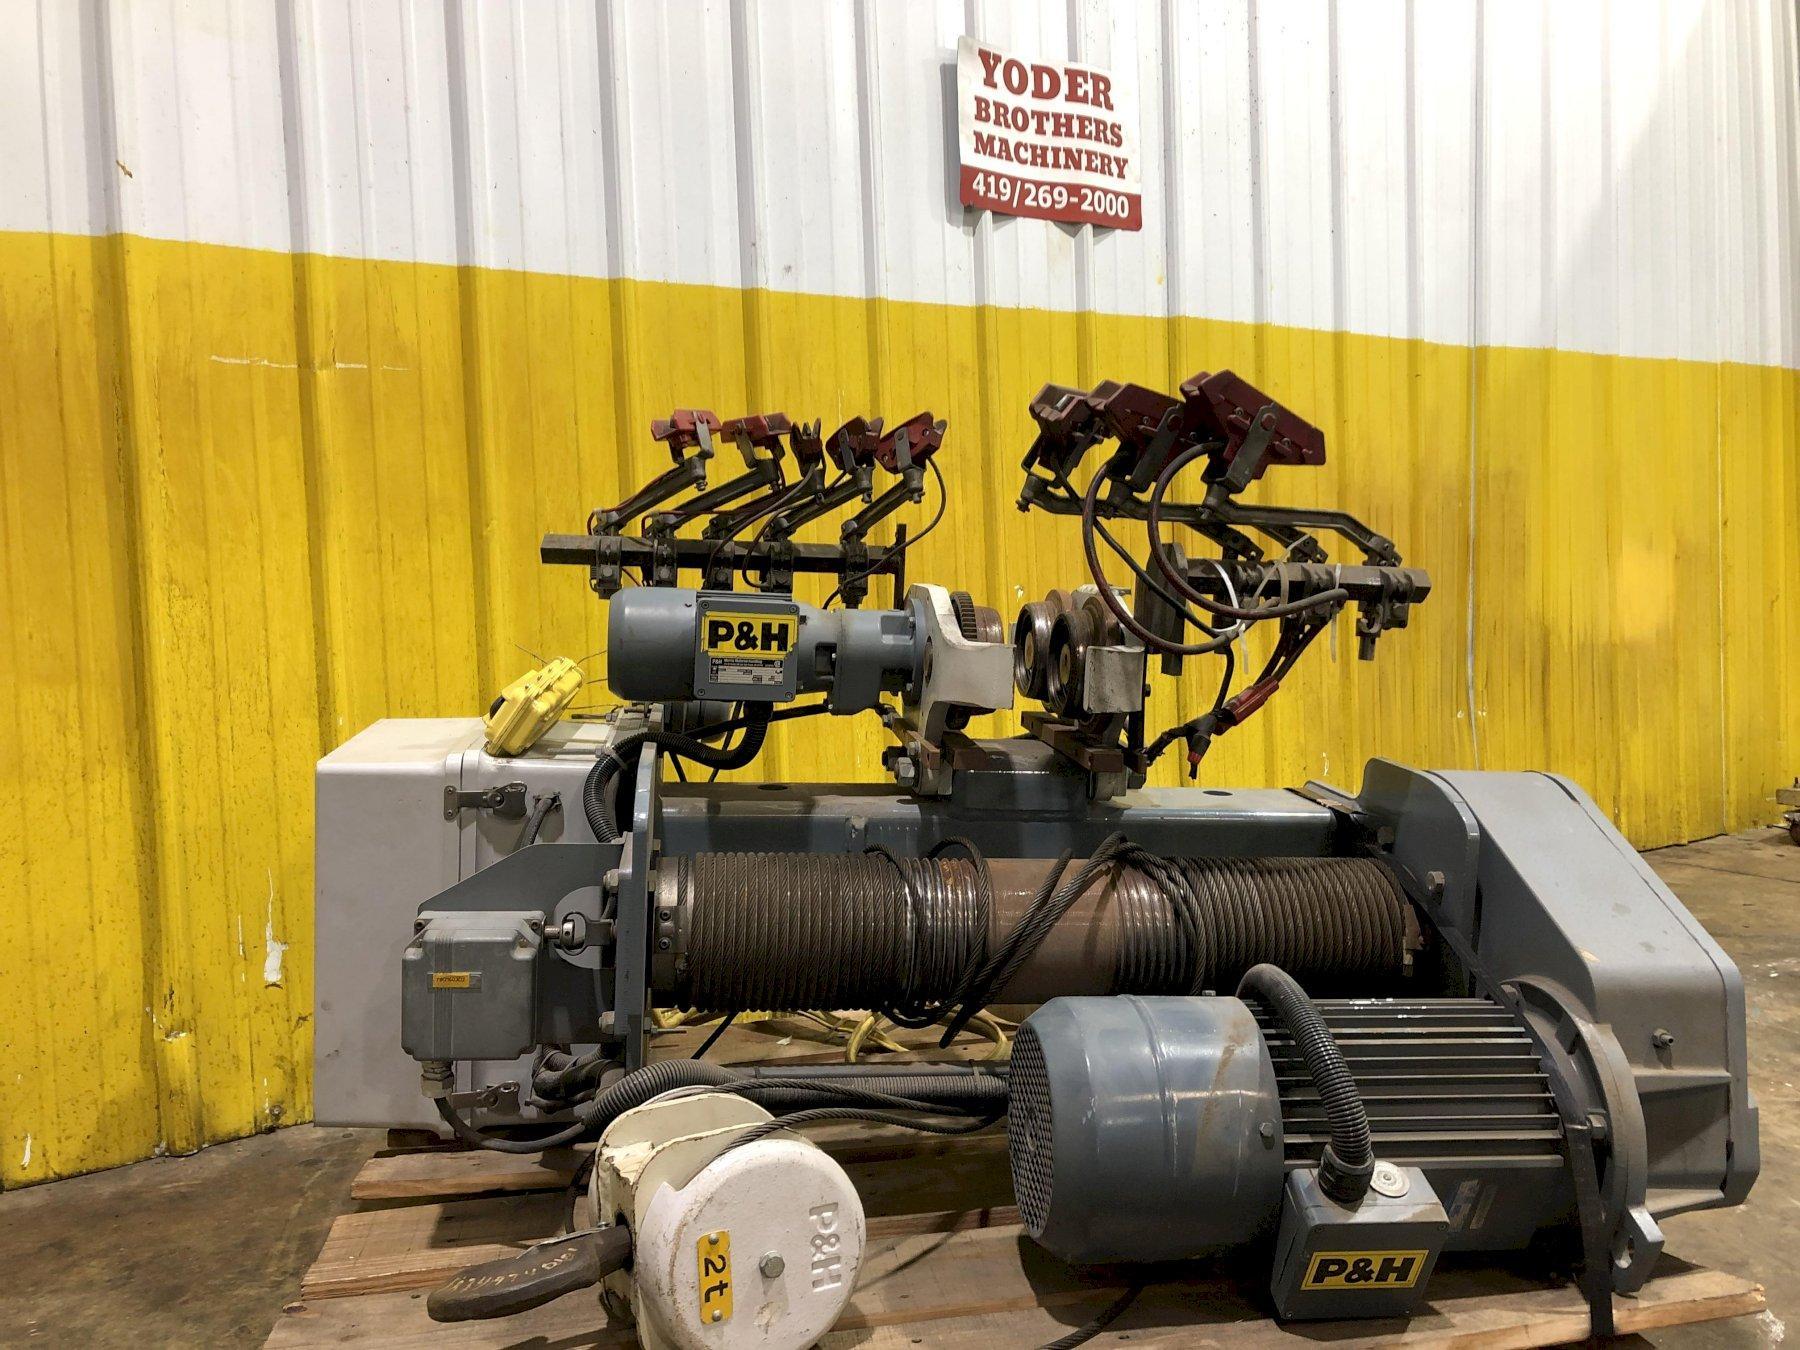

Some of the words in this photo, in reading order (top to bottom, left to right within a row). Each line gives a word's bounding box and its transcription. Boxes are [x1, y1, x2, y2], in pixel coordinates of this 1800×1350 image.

[978, 48, 1114, 111] YODER
[974, 95, 1123, 147] BROTHERS
[973, 130, 1128, 179] MACHINERY
[972, 172, 1129, 218] 419/269-2000
[708, 620, 789, 651] P&H
[809, 1202, 842, 1293] P&H
[1311, 1257, 1417, 1284] P&H
